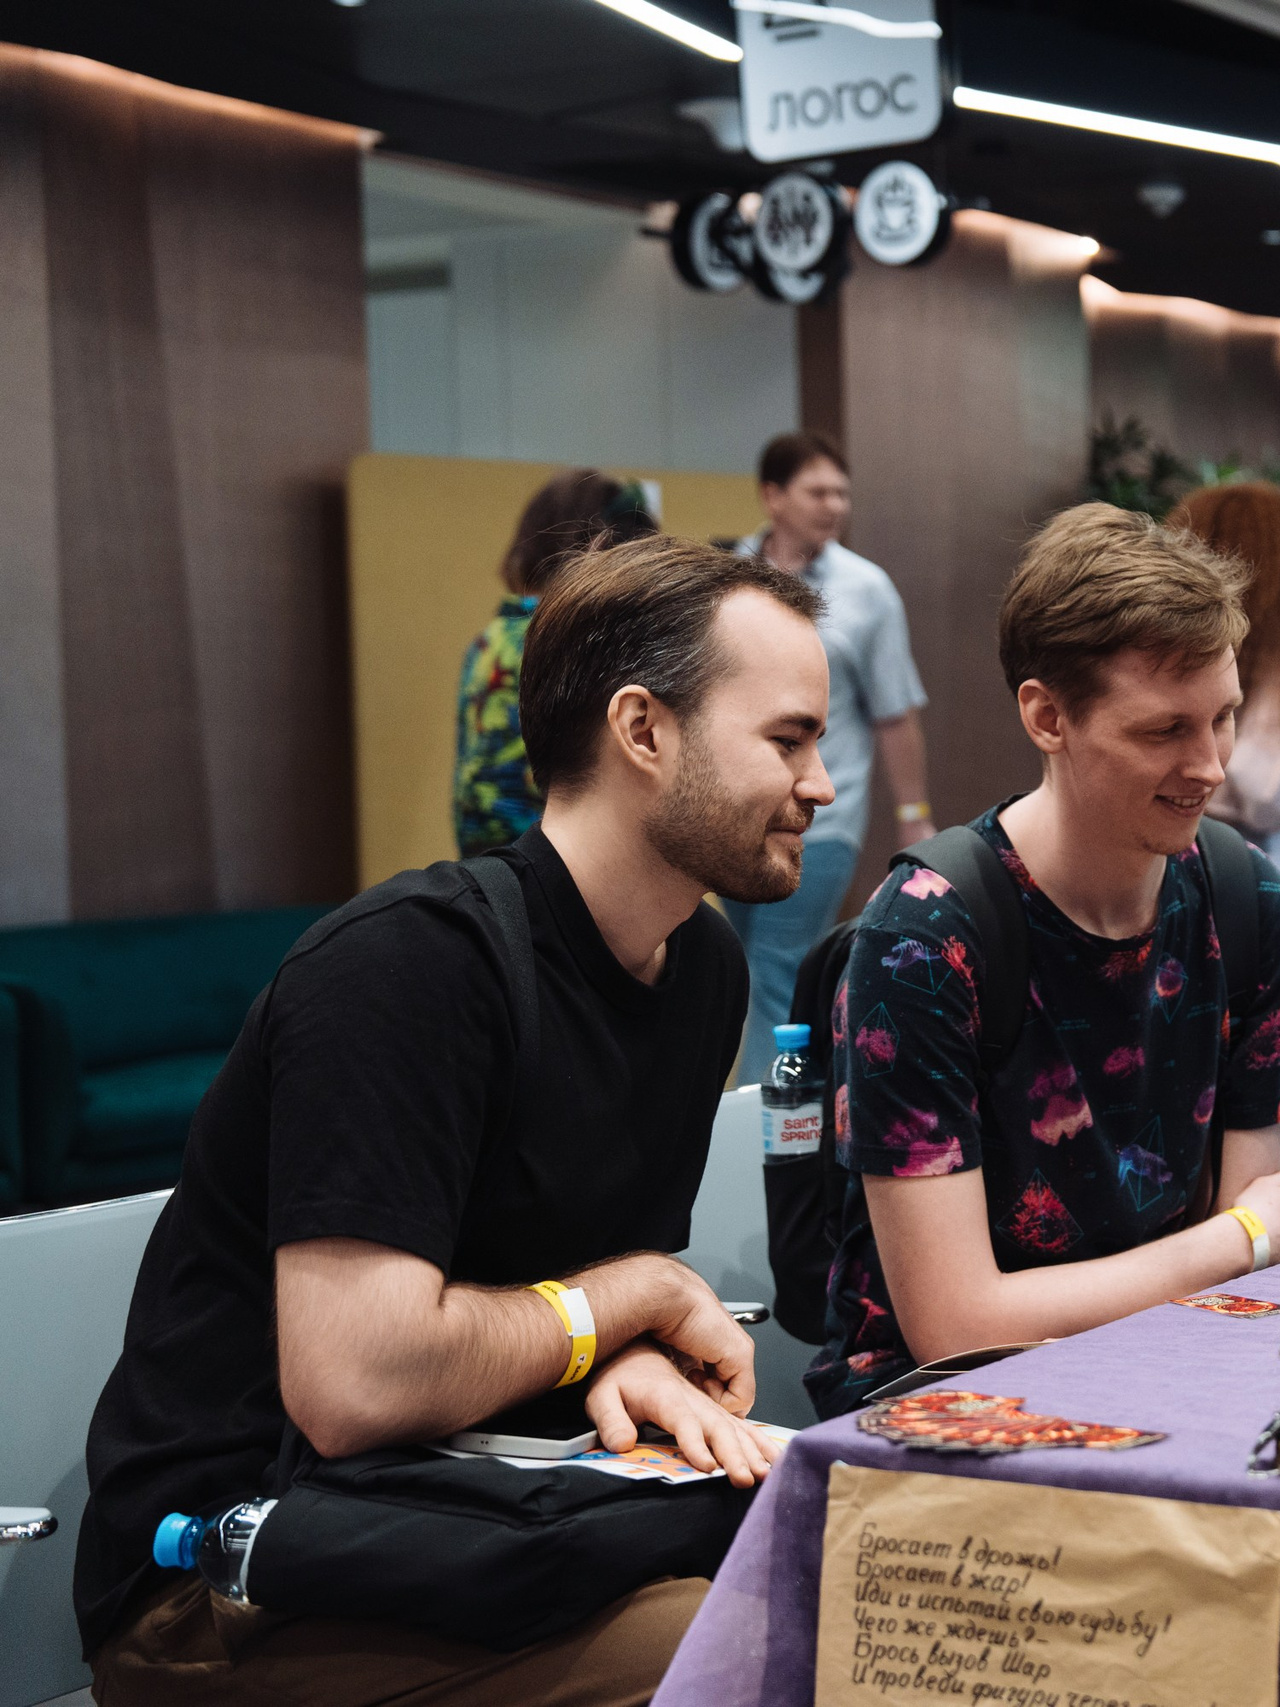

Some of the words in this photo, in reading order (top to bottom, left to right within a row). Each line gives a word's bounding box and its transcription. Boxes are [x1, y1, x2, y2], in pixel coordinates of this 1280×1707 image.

[858, 1522, 952, 1559] Бросает
[958, 1535, 973, 1560] в
[974, 1538, 1062, 1571] дрожь!
[856, 1551, 947, 1583] Бросает
[952, 1563, 965, 1588] в
[968, 1571, 1032, 1600] жар!
[854, 1580, 893, 1606] Иди
[898, 1593, 911, 1608] и
[1017, 1598, 1076, 1625] свою
[854, 1606, 898, 1634] Чего
[903, 1618, 937, 1637] же
[853, 1632, 919, 1668] Брось
[927, 1640, 991, 1678] вызов
[1002, 1651, 1051, 1684] Шар
[872, 1665, 965, 1694] проведи
